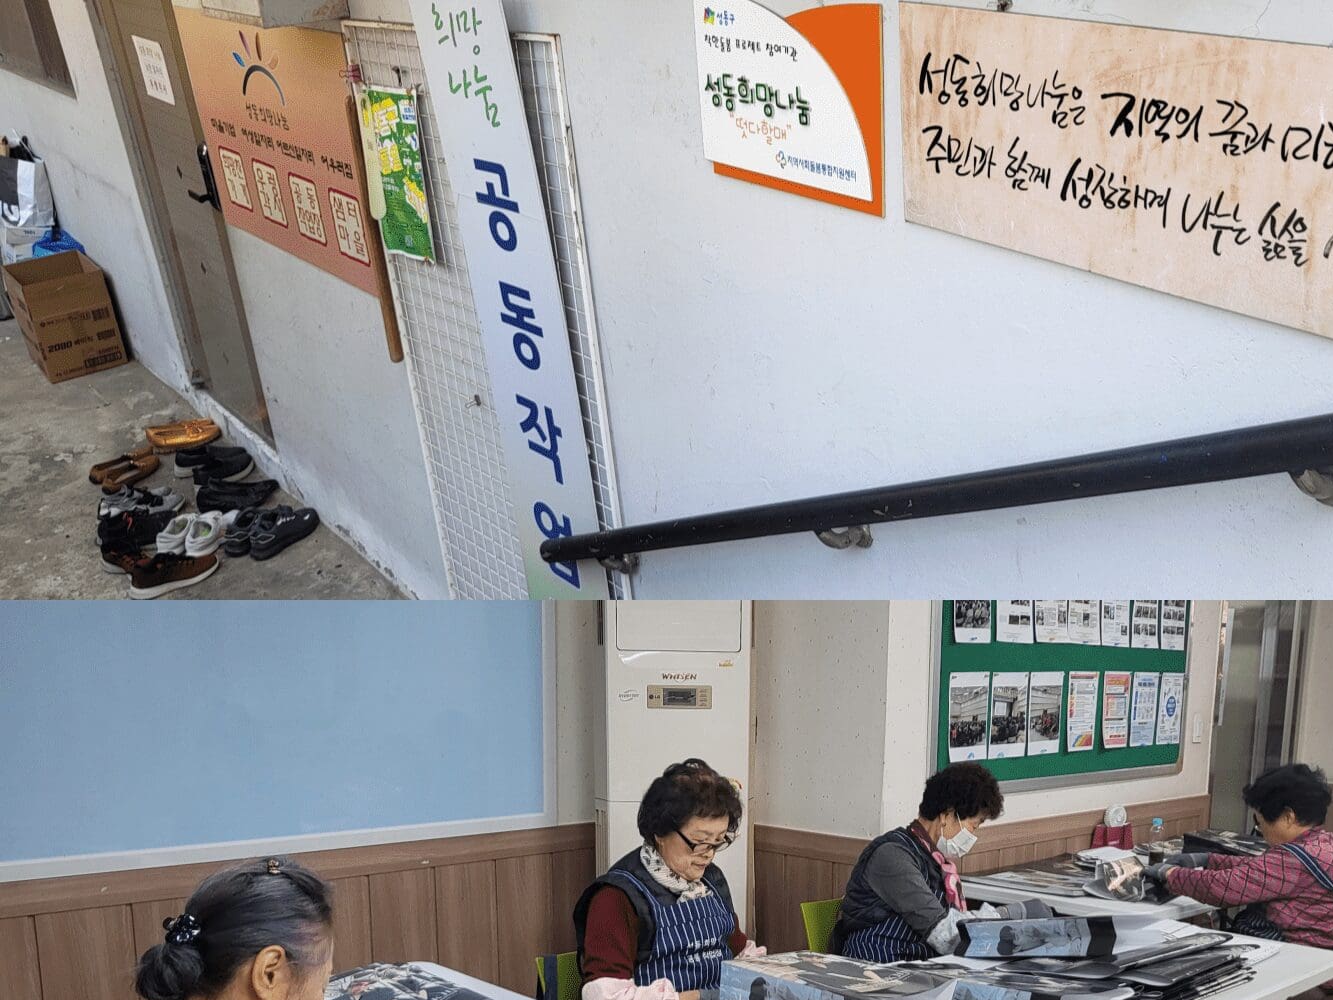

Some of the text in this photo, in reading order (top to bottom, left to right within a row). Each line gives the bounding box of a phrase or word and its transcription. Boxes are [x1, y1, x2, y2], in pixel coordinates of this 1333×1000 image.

[432, 2, 482, 55] 희망
[716, 10, 736, 27] 성동구
[735, 39, 761, 54] 프로젝트
[765, 42, 798, 62] 참여기관
[448, 65, 500, 128] 나눔
[704, 73, 812, 126] 성동희망나눔
[919, 52, 1086, 129] 성동희망나눔은
[1101, 92, 1204, 143] 지역의
[1208, 99, 1275, 157] 꿈과
[241, 127, 275, 152] 여성일자리
[922, 125, 997, 179] 주민과
[1005, 136, 1051, 191] 함께
[1060, 158, 1172, 229] 성장하며
[1181, 191, 1251, 256] 나누는
[1258, 201, 1309, 268] 삶을
[662, 672, 698, 680] WHISEN
